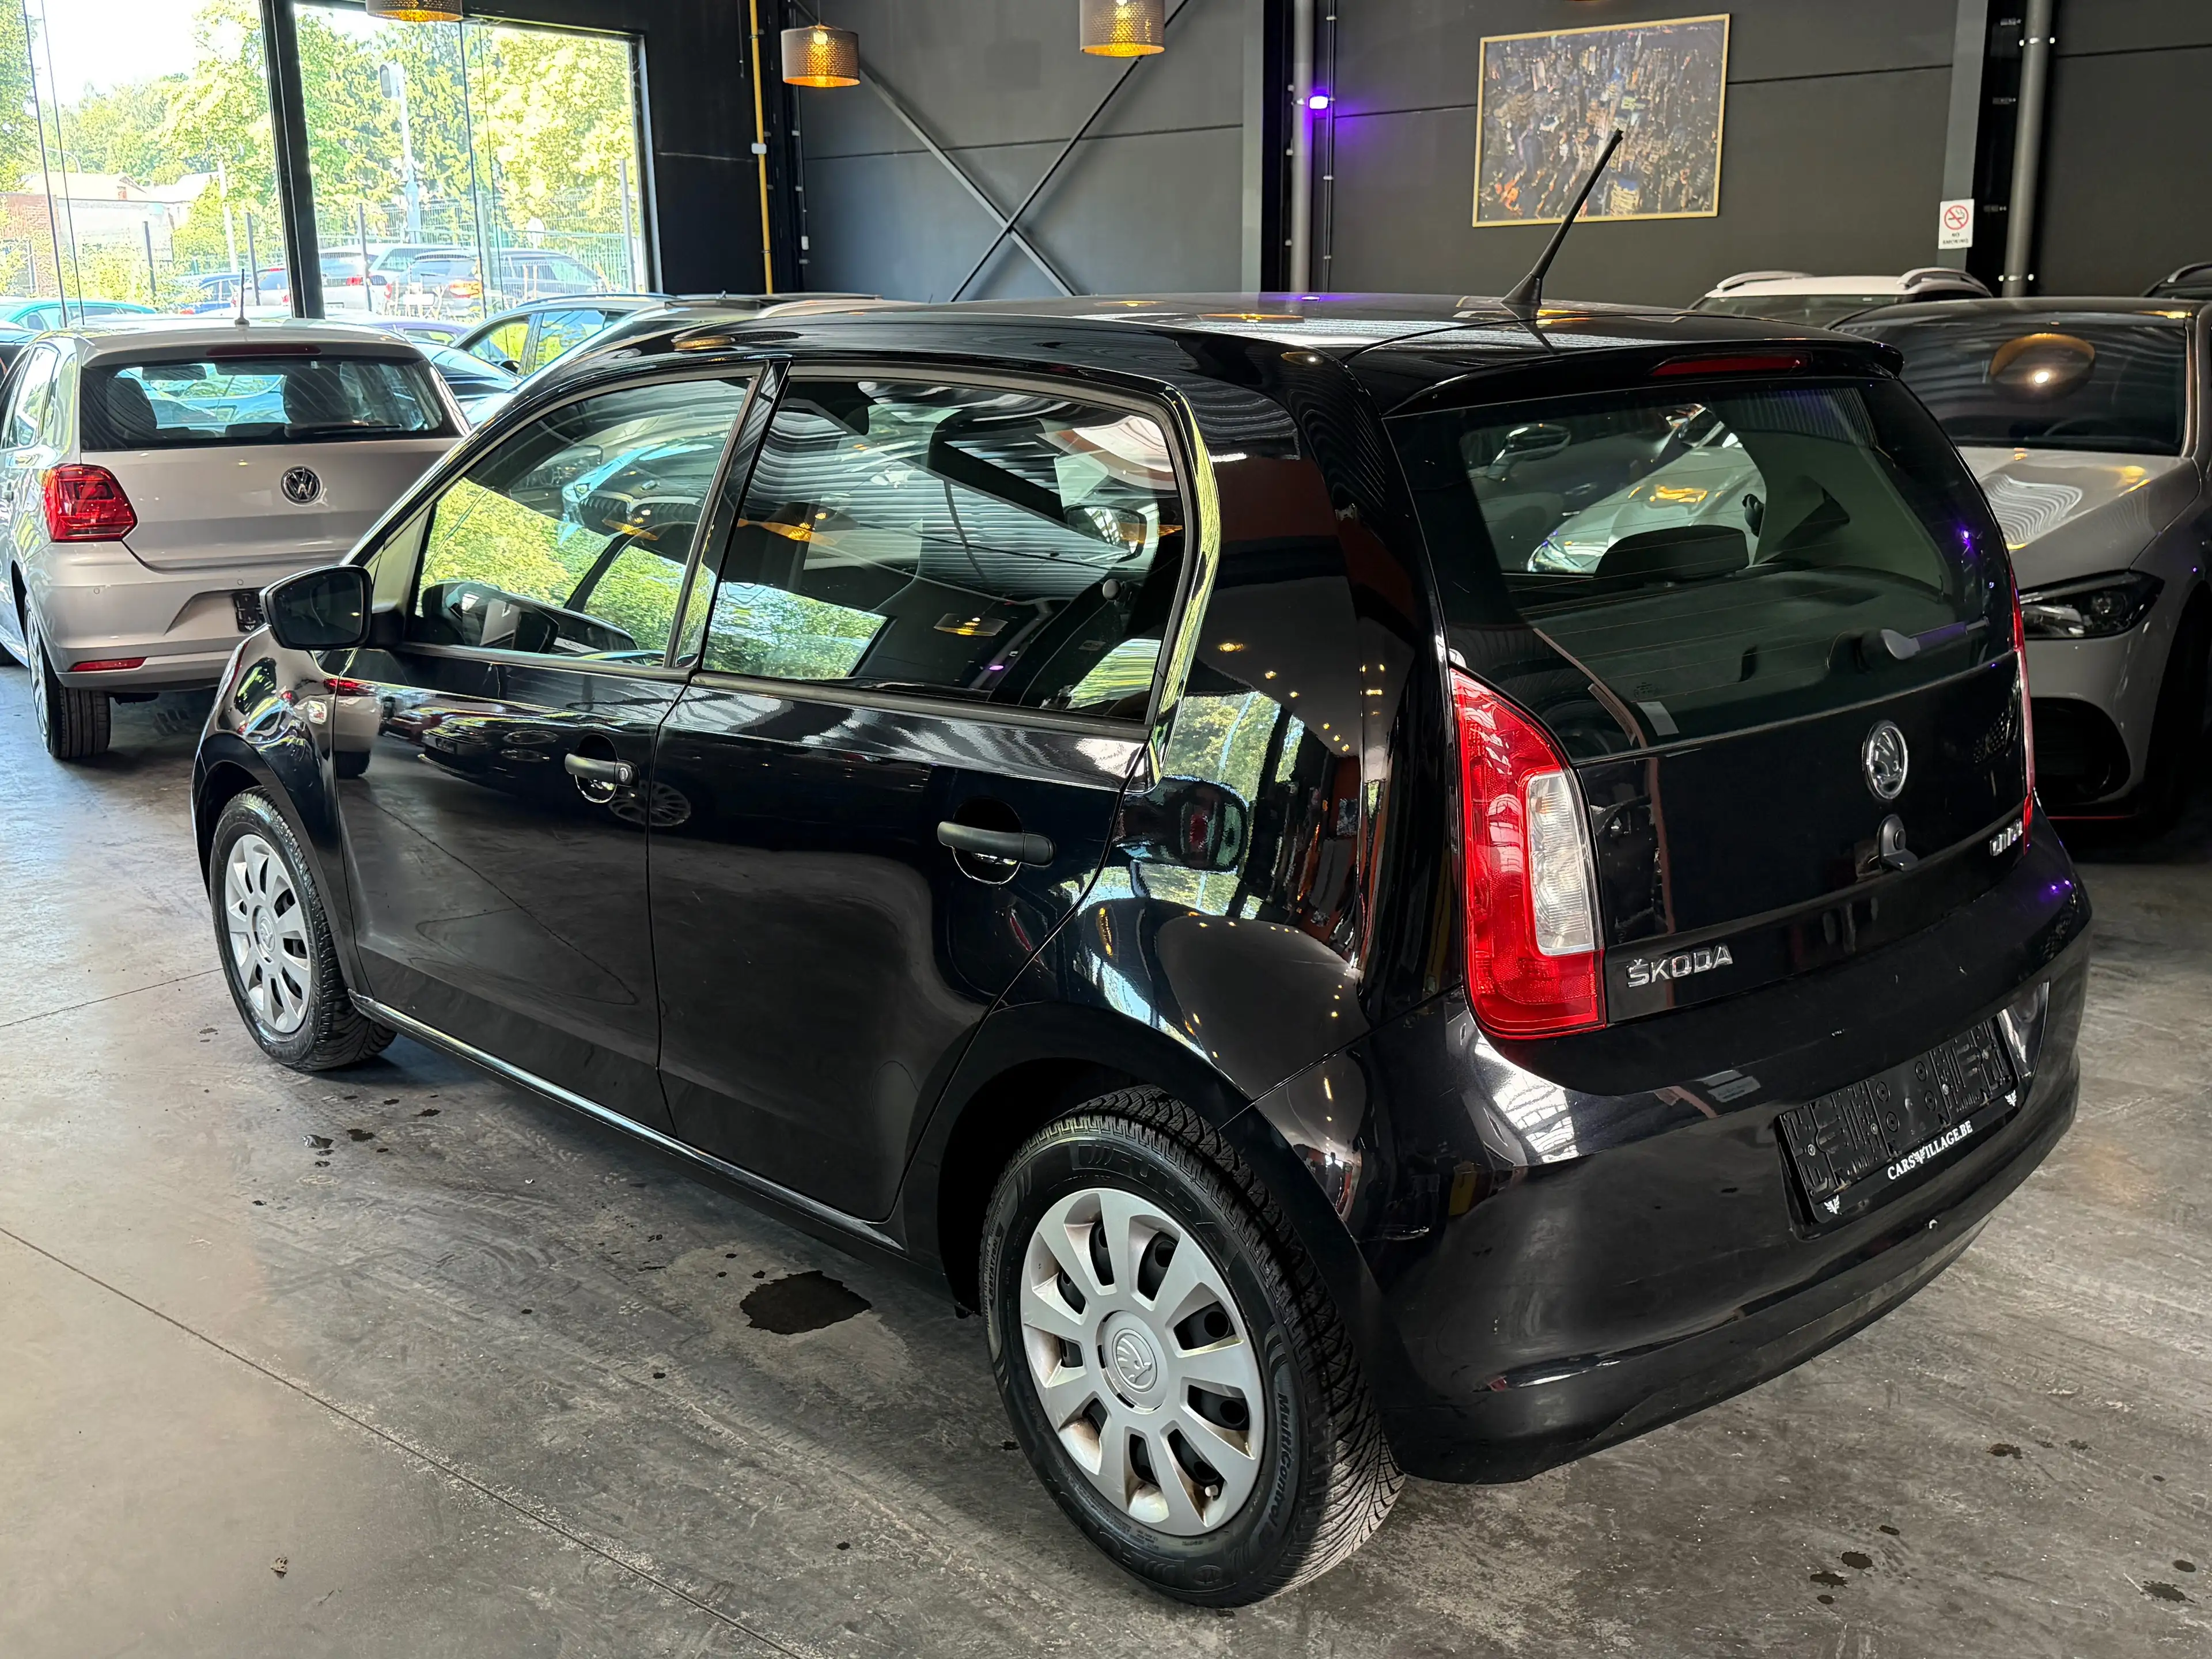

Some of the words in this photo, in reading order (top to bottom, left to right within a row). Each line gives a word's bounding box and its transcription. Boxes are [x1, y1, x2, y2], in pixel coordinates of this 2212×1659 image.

[1626, 943, 1733, 988] ŠKODA
[1887, 1120, 1973, 1180] CARSVILLAGE.BE
[1269, 1392, 1292, 1527] MultiControl
